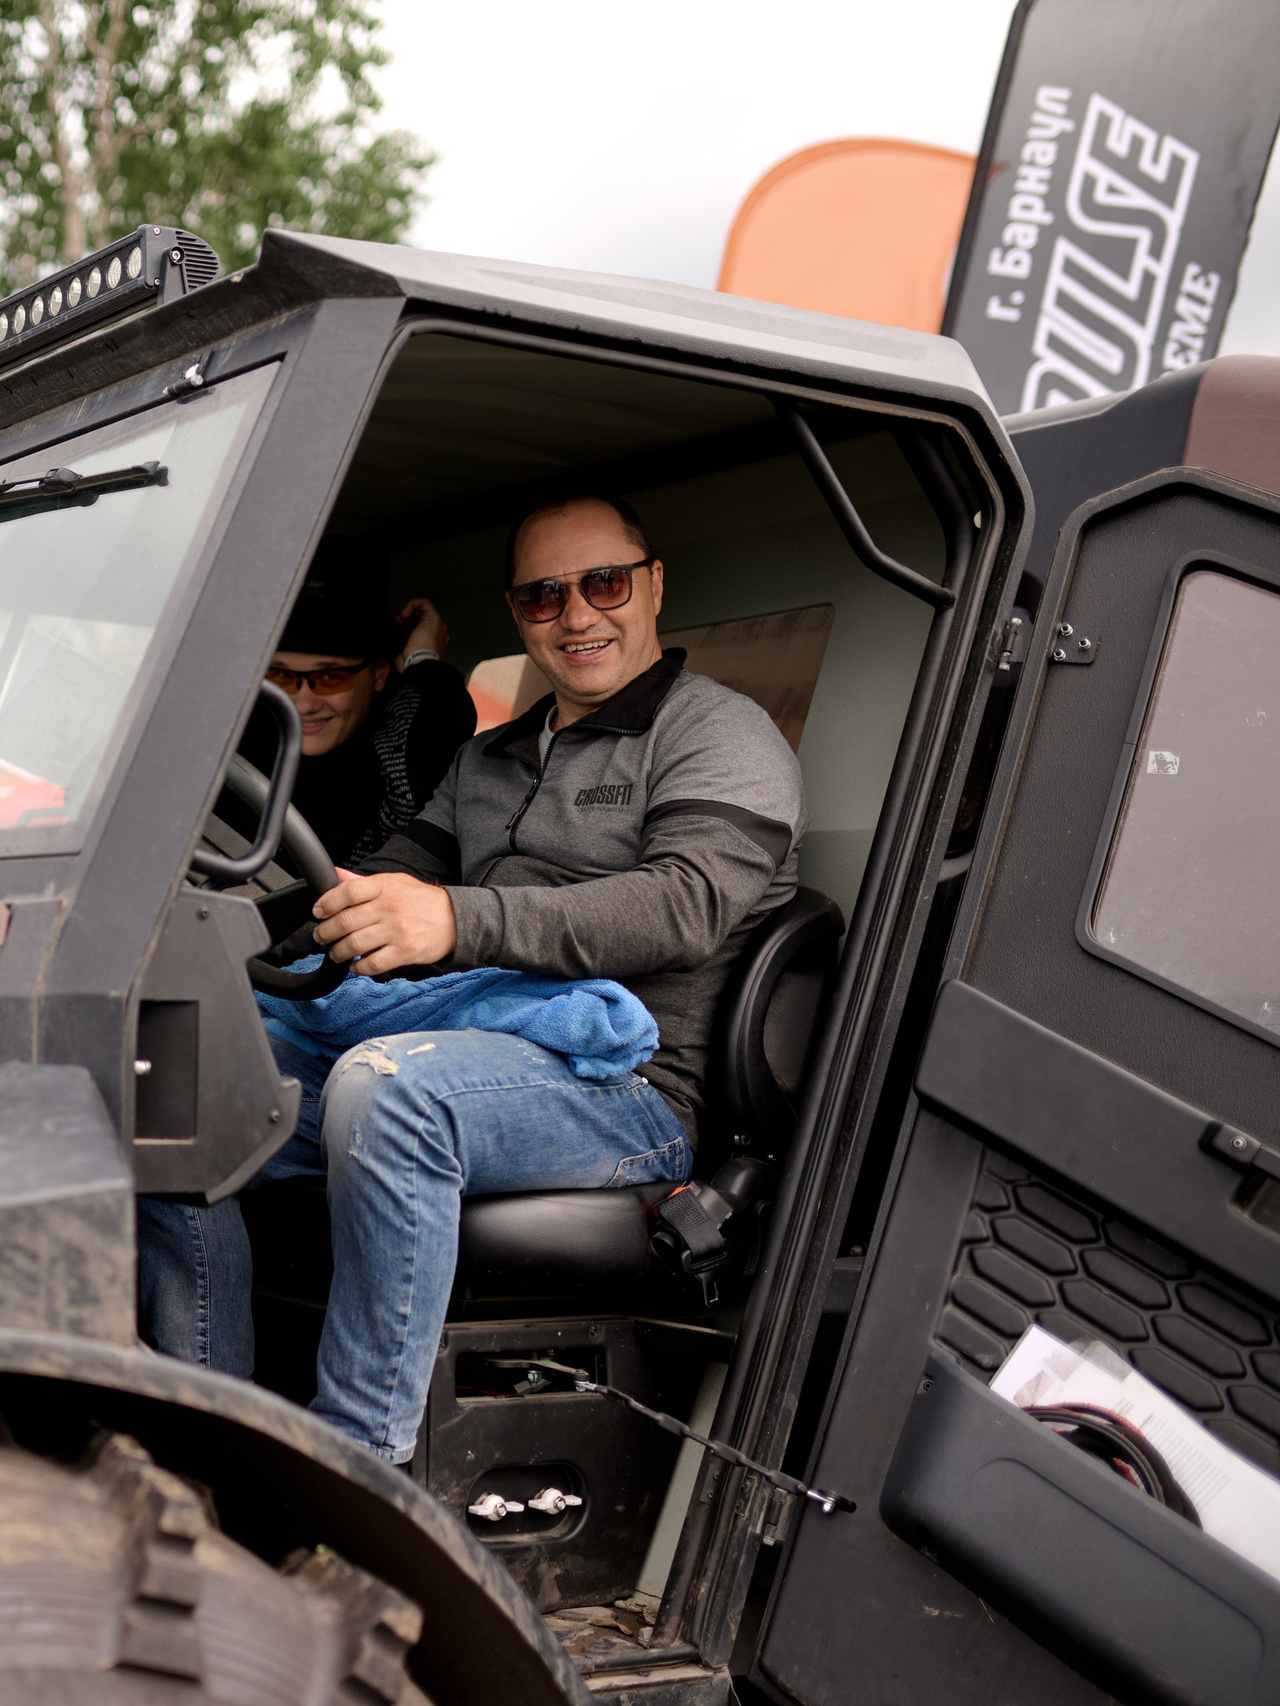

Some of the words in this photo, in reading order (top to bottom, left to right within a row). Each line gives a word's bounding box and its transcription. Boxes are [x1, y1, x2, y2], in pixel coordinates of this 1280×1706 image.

[987, 84, 1075, 280] Барнаул
[1160, 261, 1221, 377] EME
[573, 784, 634, 807] CROSSFIT
